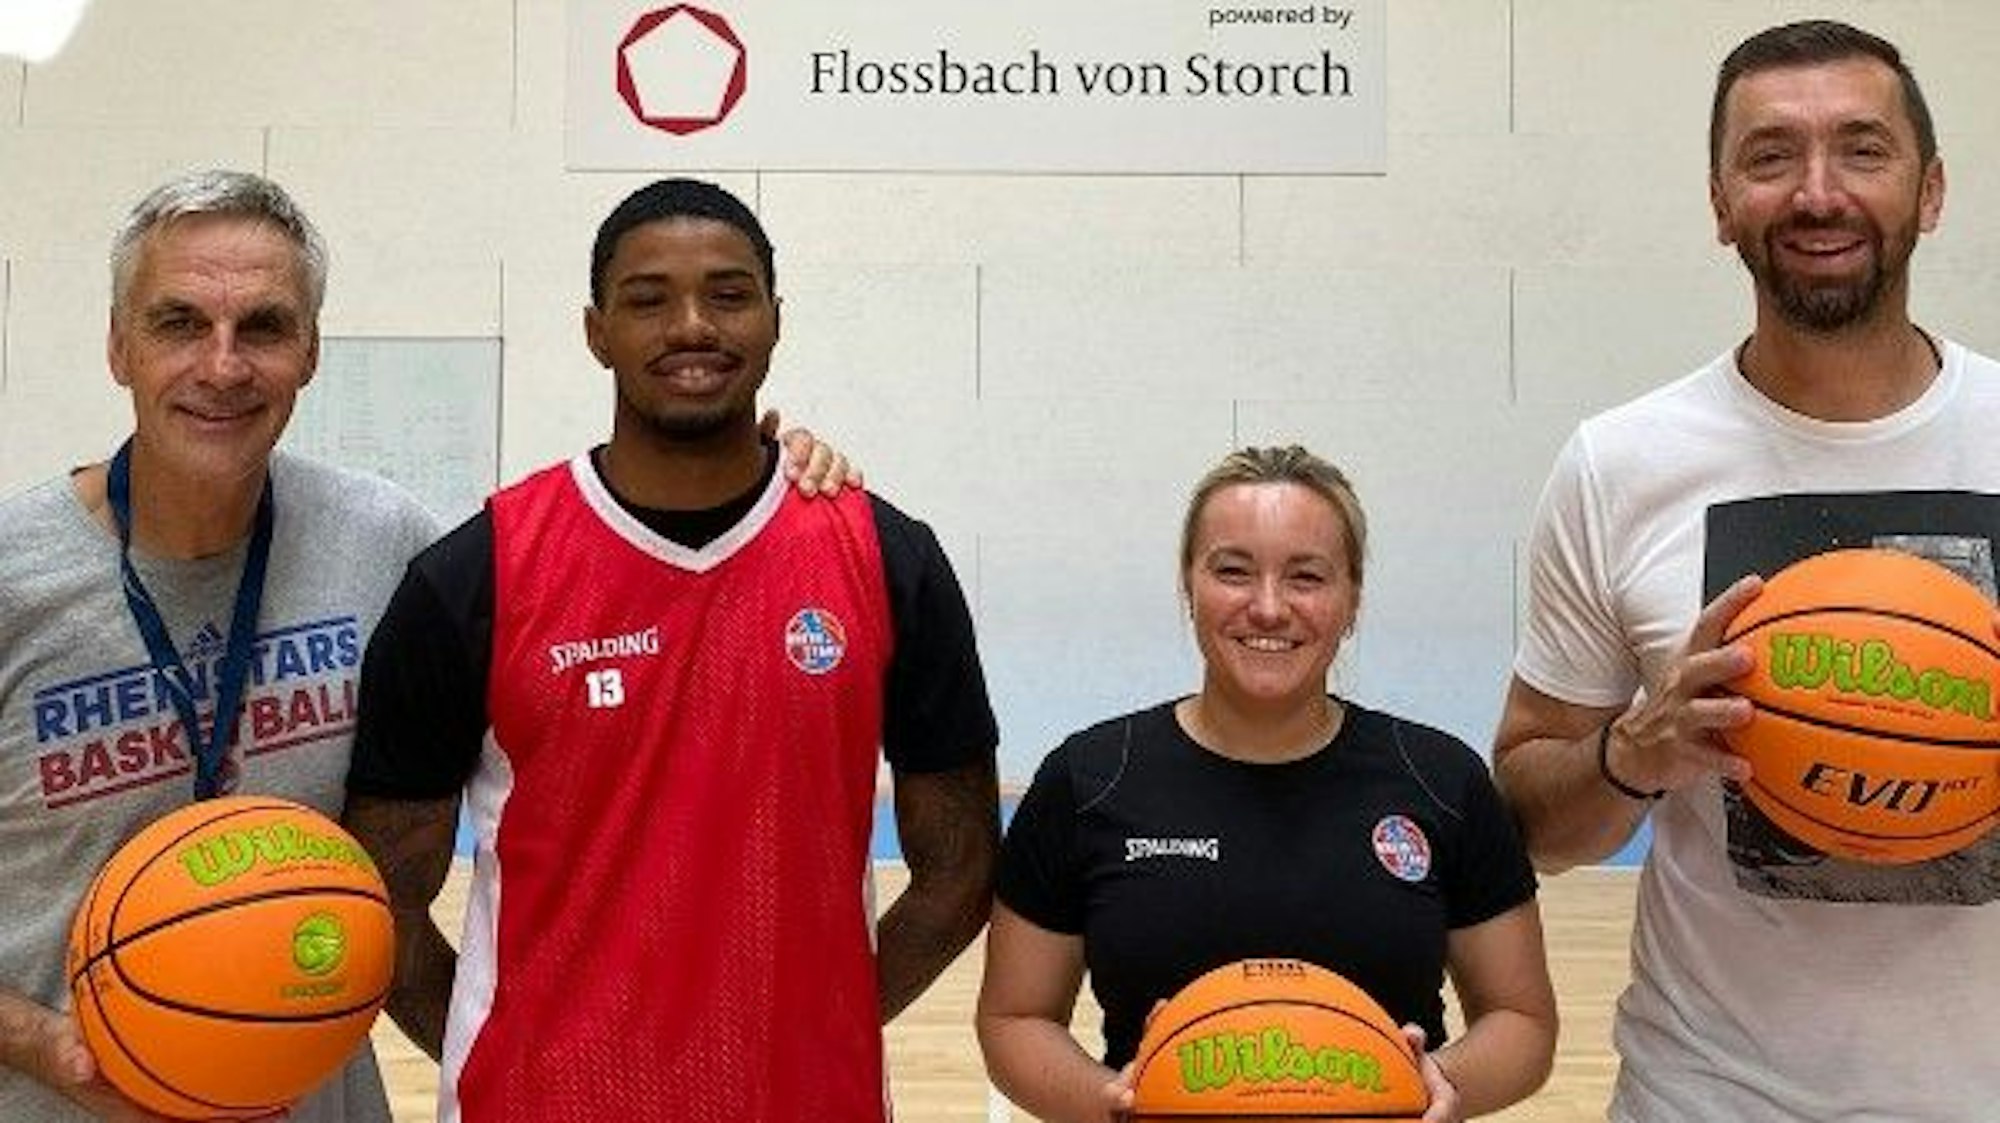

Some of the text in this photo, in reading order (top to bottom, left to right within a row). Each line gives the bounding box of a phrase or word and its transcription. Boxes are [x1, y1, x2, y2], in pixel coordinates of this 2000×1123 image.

[1208, 3, 1353, 28] powered by
[810, 49, 1353, 97] Flossbach von Storch
[549, 625, 660, 675] SPALDING
[585, 667, 625, 708] 13
[1770, 632, 1990, 720] Wilson
[1125, 838, 1219, 862] SPALDING
[1178, 1026, 1388, 1094] Wilson
